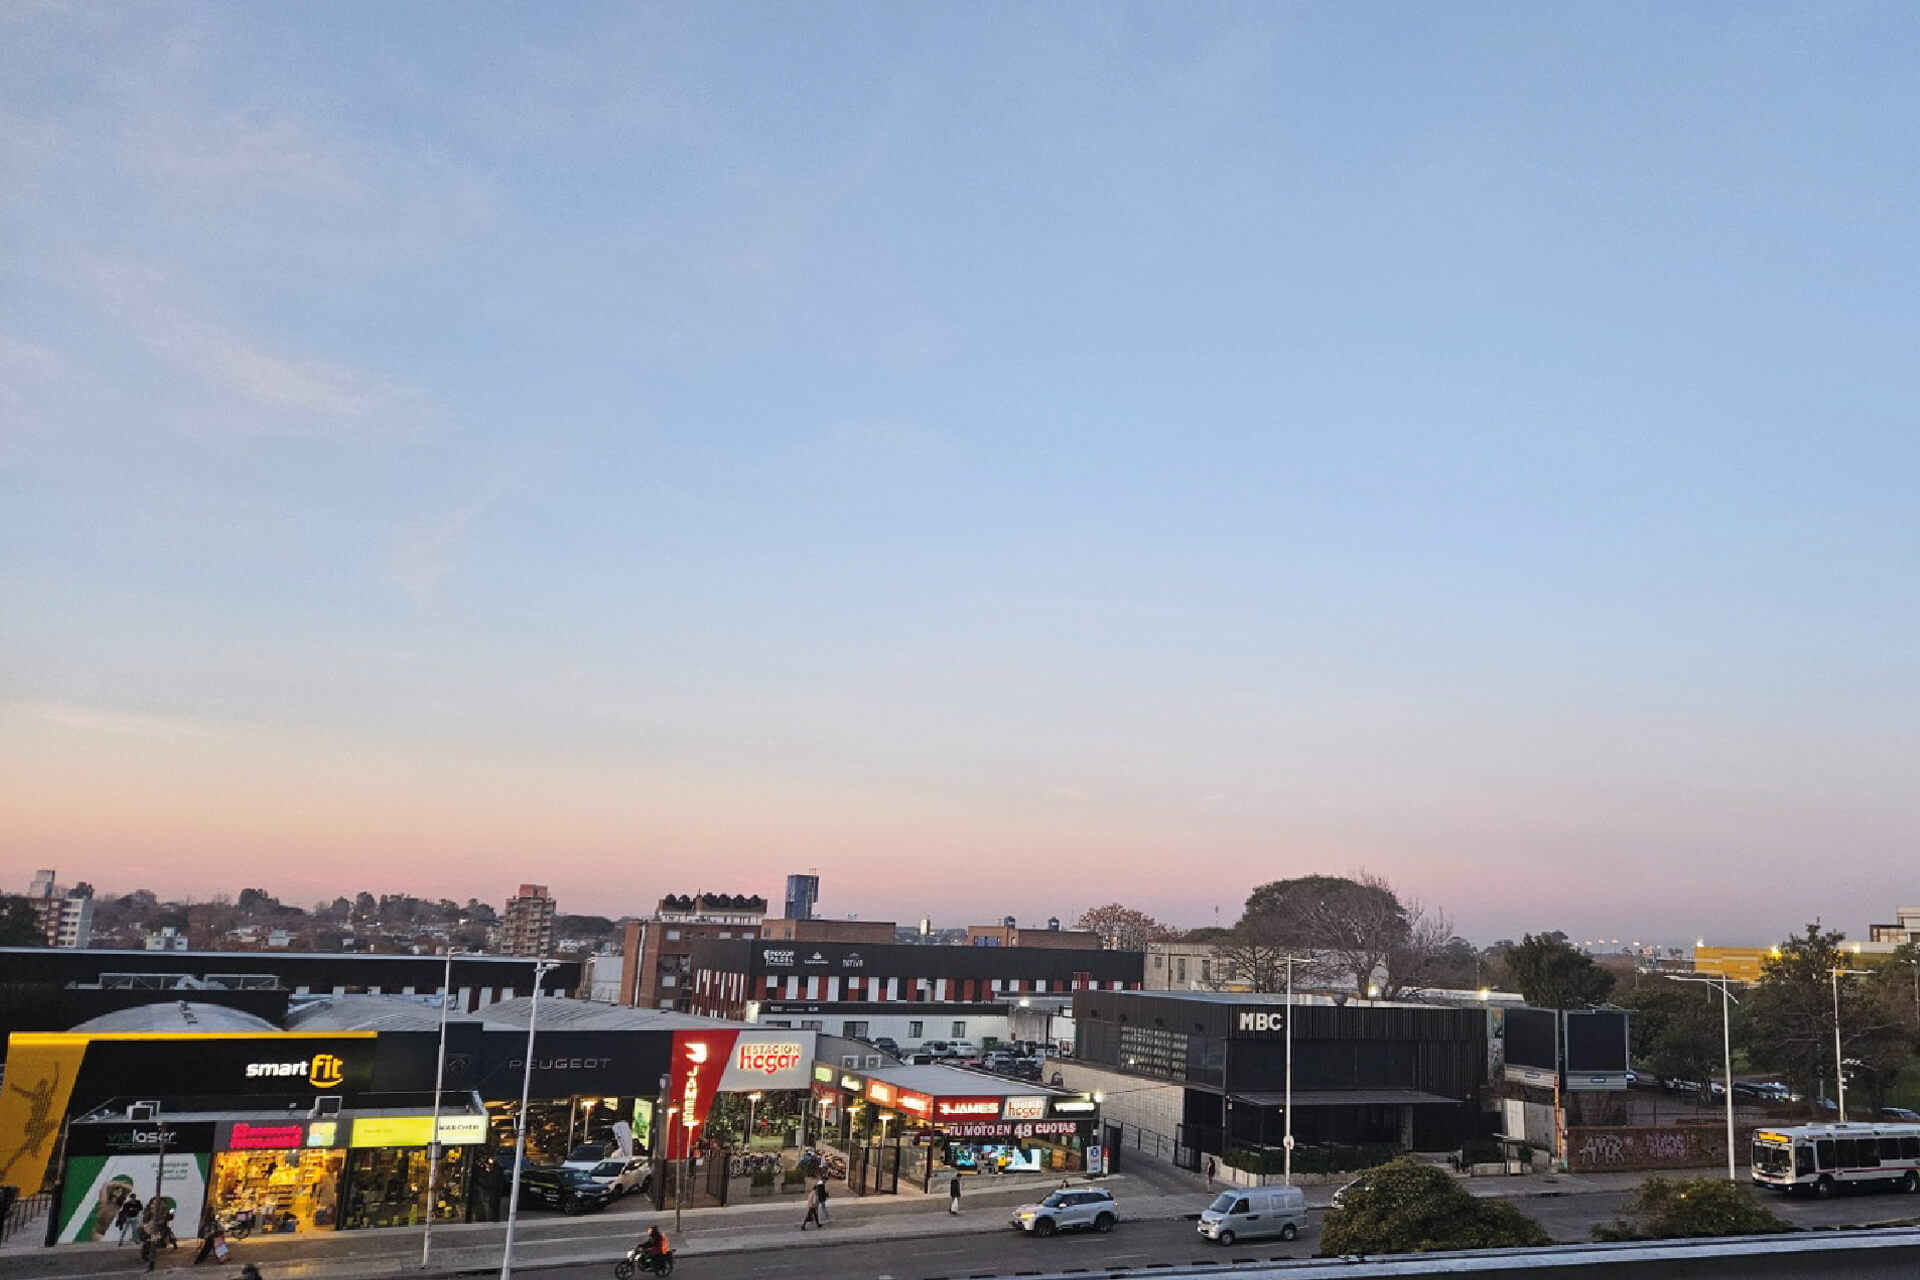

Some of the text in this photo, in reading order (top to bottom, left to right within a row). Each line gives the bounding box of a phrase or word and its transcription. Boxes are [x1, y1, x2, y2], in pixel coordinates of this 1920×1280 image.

[1239, 1012, 1282, 1031] MBC
[246, 1054, 343, 1079] smart fit
[509, 1058, 612, 1070] PEUGEOT
[739, 1045, 800, 1074] hogar
[952, 1102, 999, 1114] JAMES
[950, 1122, 1077, 1138] TU MOTO EN 48 CUOTAS
